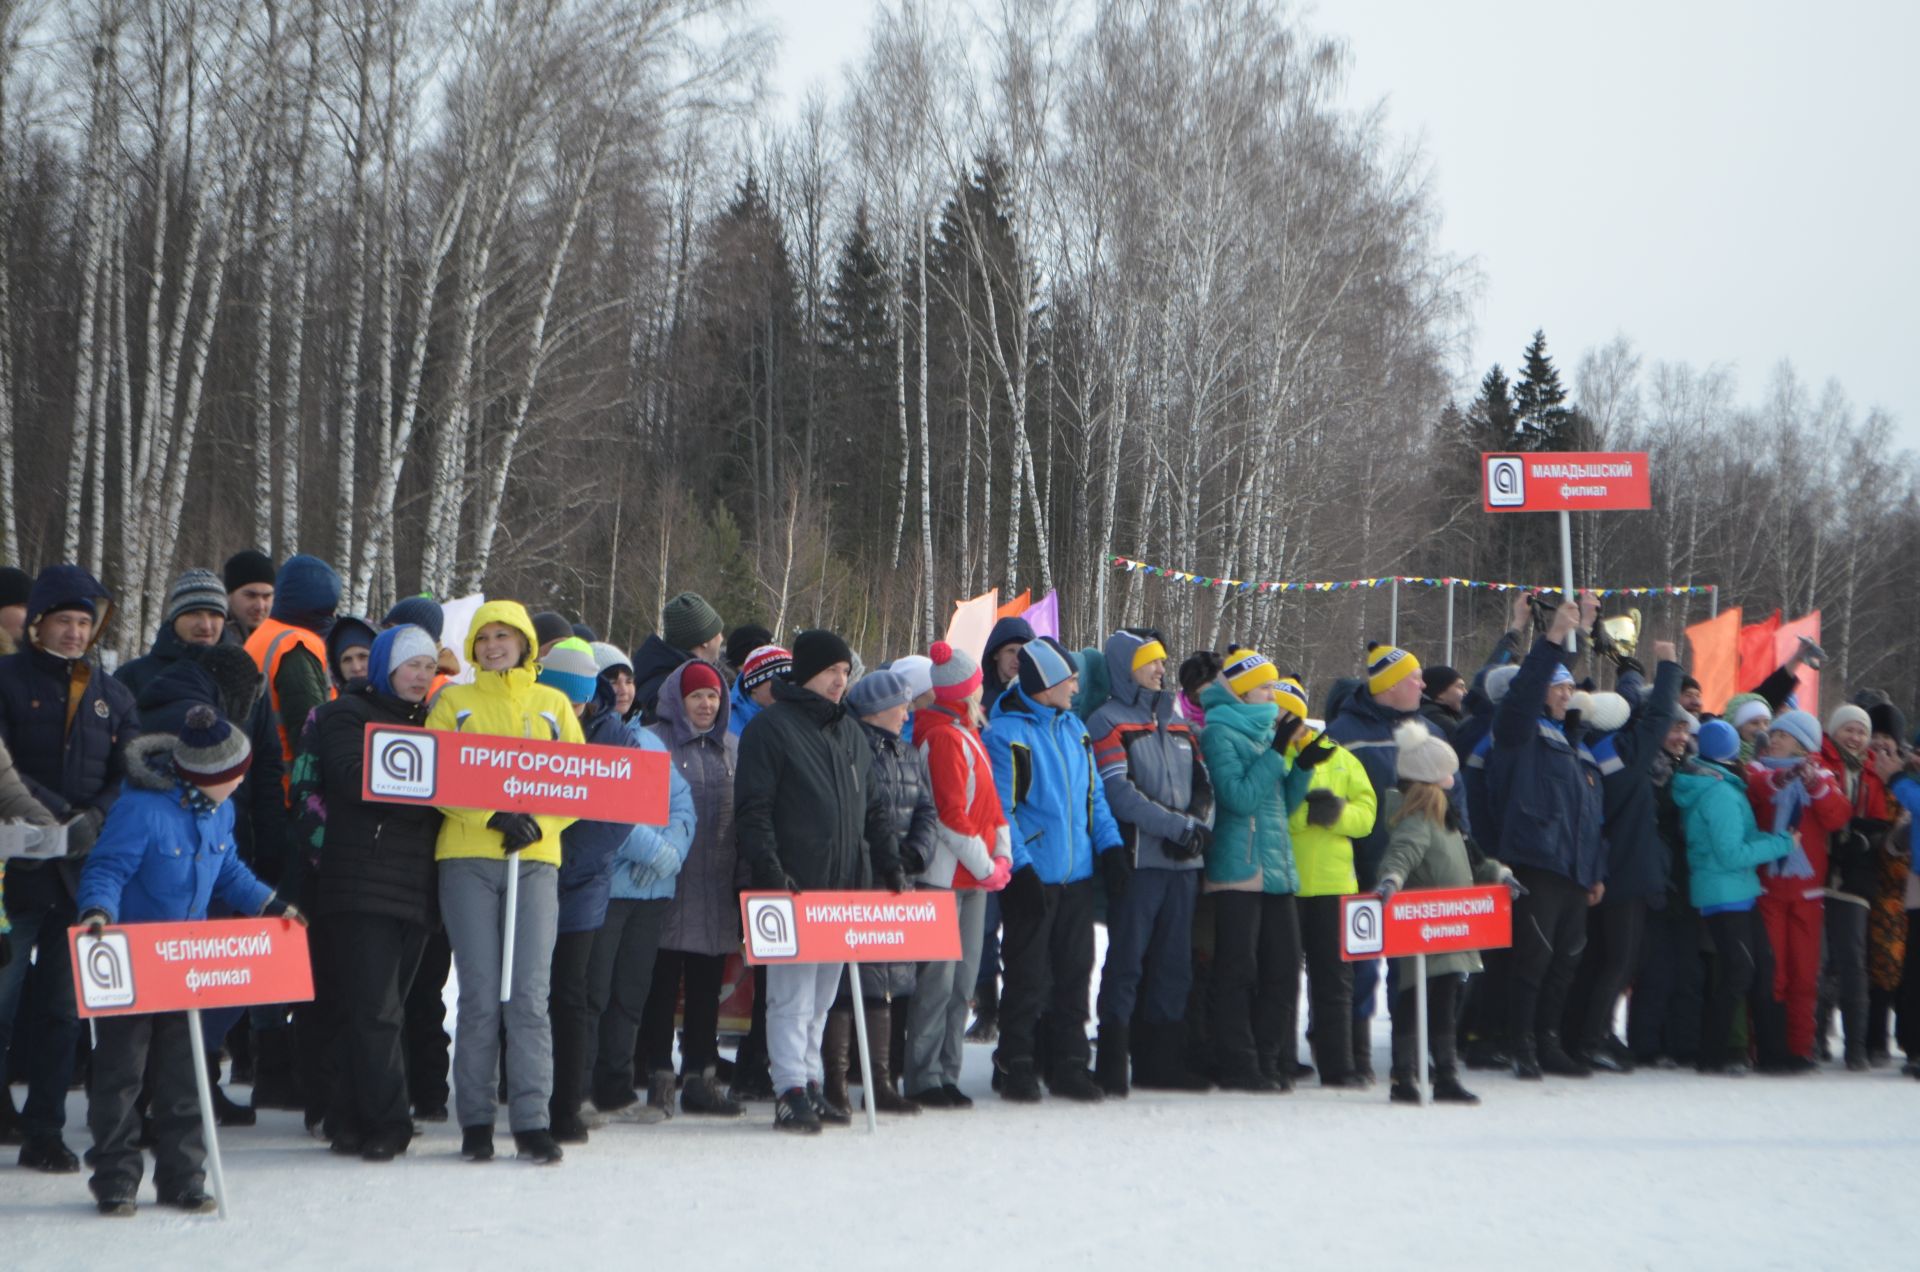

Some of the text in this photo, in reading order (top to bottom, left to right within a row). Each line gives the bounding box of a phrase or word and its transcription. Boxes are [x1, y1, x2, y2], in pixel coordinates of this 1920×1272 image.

[1532, 461, 1632, 480] МАМАДЫШСКИЙ
[1560, 484, 1607, 499] филиал
[460, 746, 631, 780] ПРИГОРОДНЫЙ
[503, 776, 588, 801] филиал
[806, 903, 936, 922] НИЖНЕКАМСКИЙ
[1393, 897, 1494, 920] МЕНЗЕЛИНСКИЙ
[845, 930, 905, 947] филиал
[1421, 923, 1470, 942] филиал
[155, 931, 271, 961] ЧЕЛНИНСКИЙ
[185, 968, 251, 993] филиал
